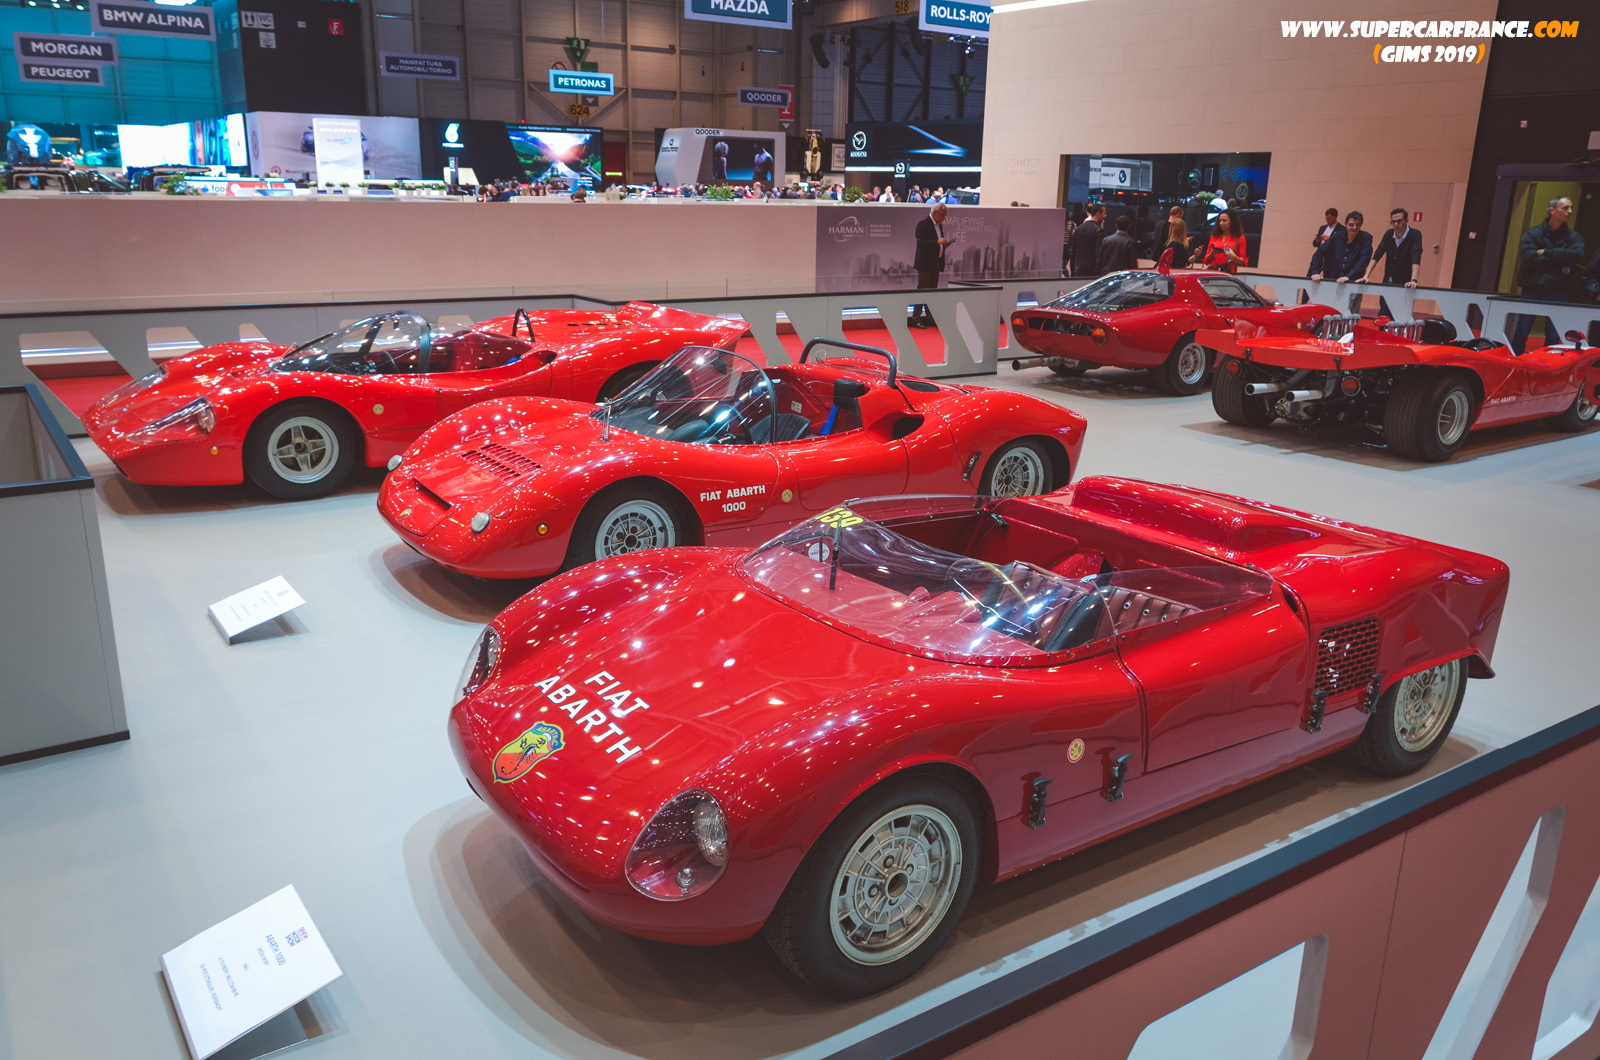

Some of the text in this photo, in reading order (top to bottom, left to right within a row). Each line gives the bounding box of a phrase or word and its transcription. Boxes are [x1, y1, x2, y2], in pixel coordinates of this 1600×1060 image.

[710, 0, 769, 14] MAZDA
[896, 1, 909, 13] 518
[104, 10, 204, 28] BMW ALPINA
[931, 5, 990, 24] ROLLS-ROY
[31, 42, 102, 56] MORGAN
[31, 67, 90, 79] PEUGEOT
[390, 65, 428, 73] AUTOMOBILI
[558, 77, 606, 88] PETRONAS
[747, 93, 782, 102] QOODER
[570, 105, 590, 115] 624
[700, 485, 766, 502] FIAT ABARTH
[722, 502, 746, 513] 1000
[583, 670, 650, 717] FIAT
[533, 676, 642, 764] ABARTH
[265, 933, 286, 965] ABARTH 1000
